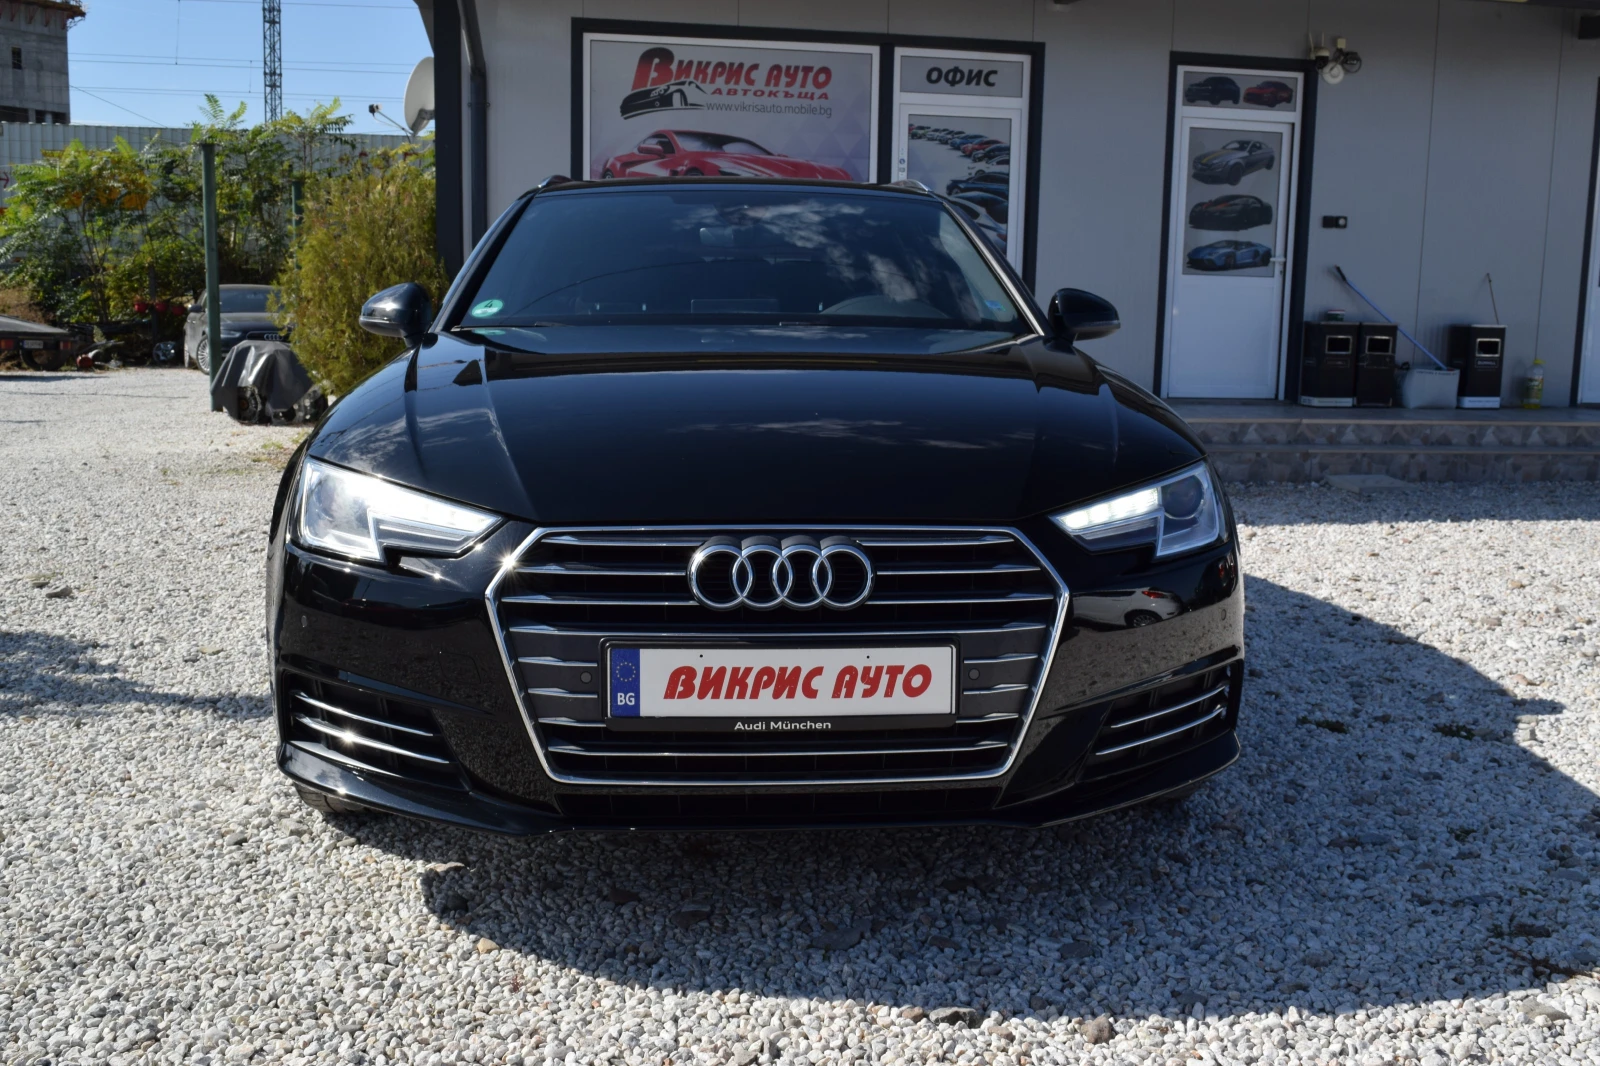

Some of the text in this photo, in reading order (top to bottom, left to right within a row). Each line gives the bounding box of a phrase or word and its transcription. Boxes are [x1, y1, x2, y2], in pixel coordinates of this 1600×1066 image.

[764, 64, 832, 90] АУТО
[925, 66, 998, 88] ОФИС
[710, 87, 829, 101] АВТОКЪЩА
[705, 101, 832, 118] www.vikrisauto.mobile.bg
[484, 300, 493, 308] 4
[663, 664, 933, 700] ВИКРИС АУТО
[617, 692, 635, 706] BG
[734, 719, 832, 730] Audi München
